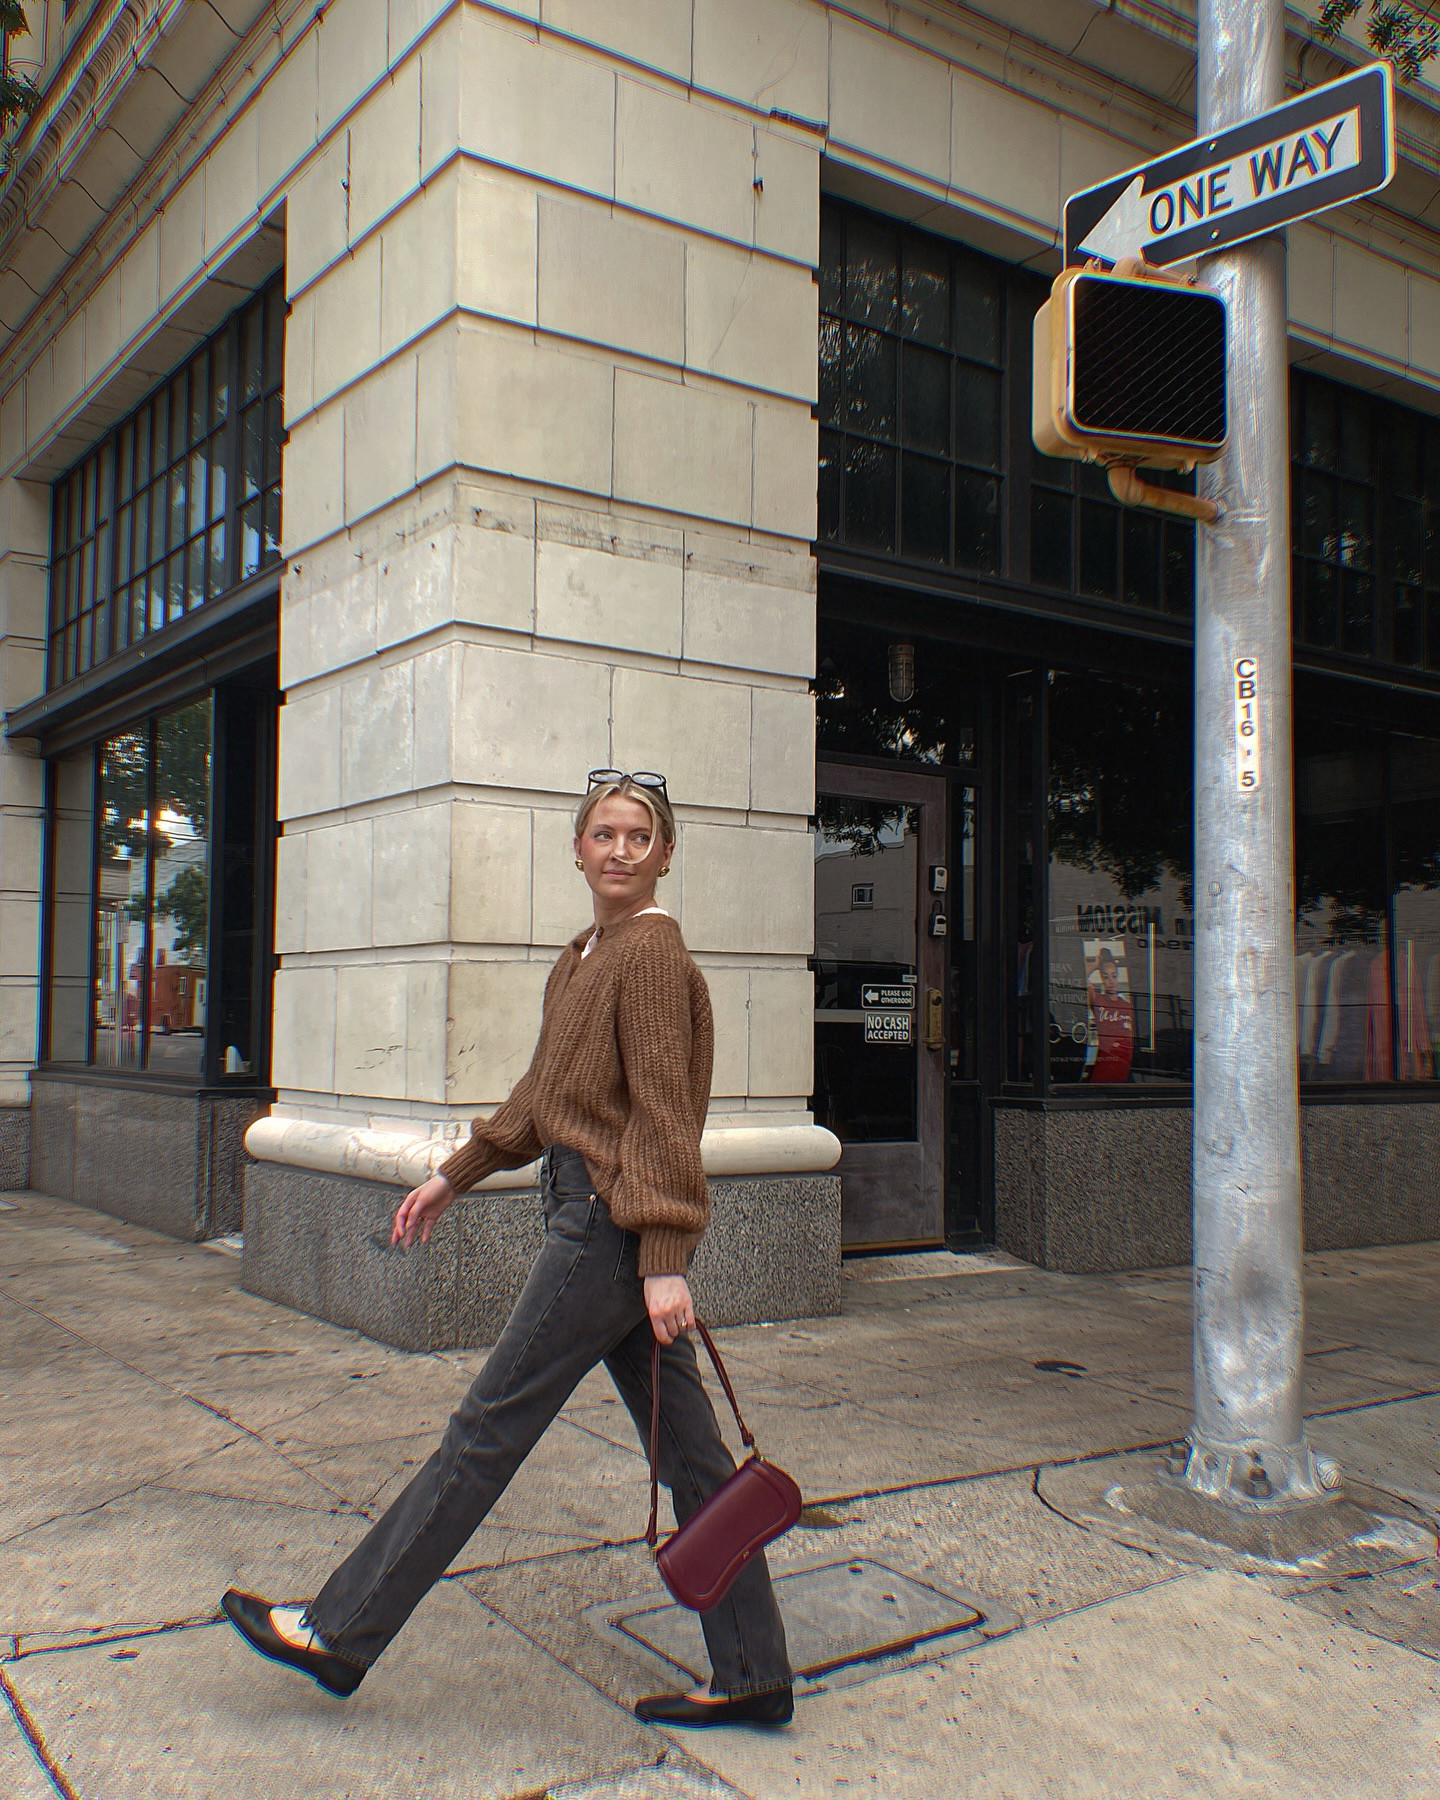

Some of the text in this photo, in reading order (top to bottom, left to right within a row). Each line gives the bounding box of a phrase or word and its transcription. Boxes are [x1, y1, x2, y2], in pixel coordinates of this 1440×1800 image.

[1149, 118, 1346, 235] ONE WAY
[867, 1016, 909, 1030] NO CASH
[867, 1030, 909, 1040] ACCEPTED
